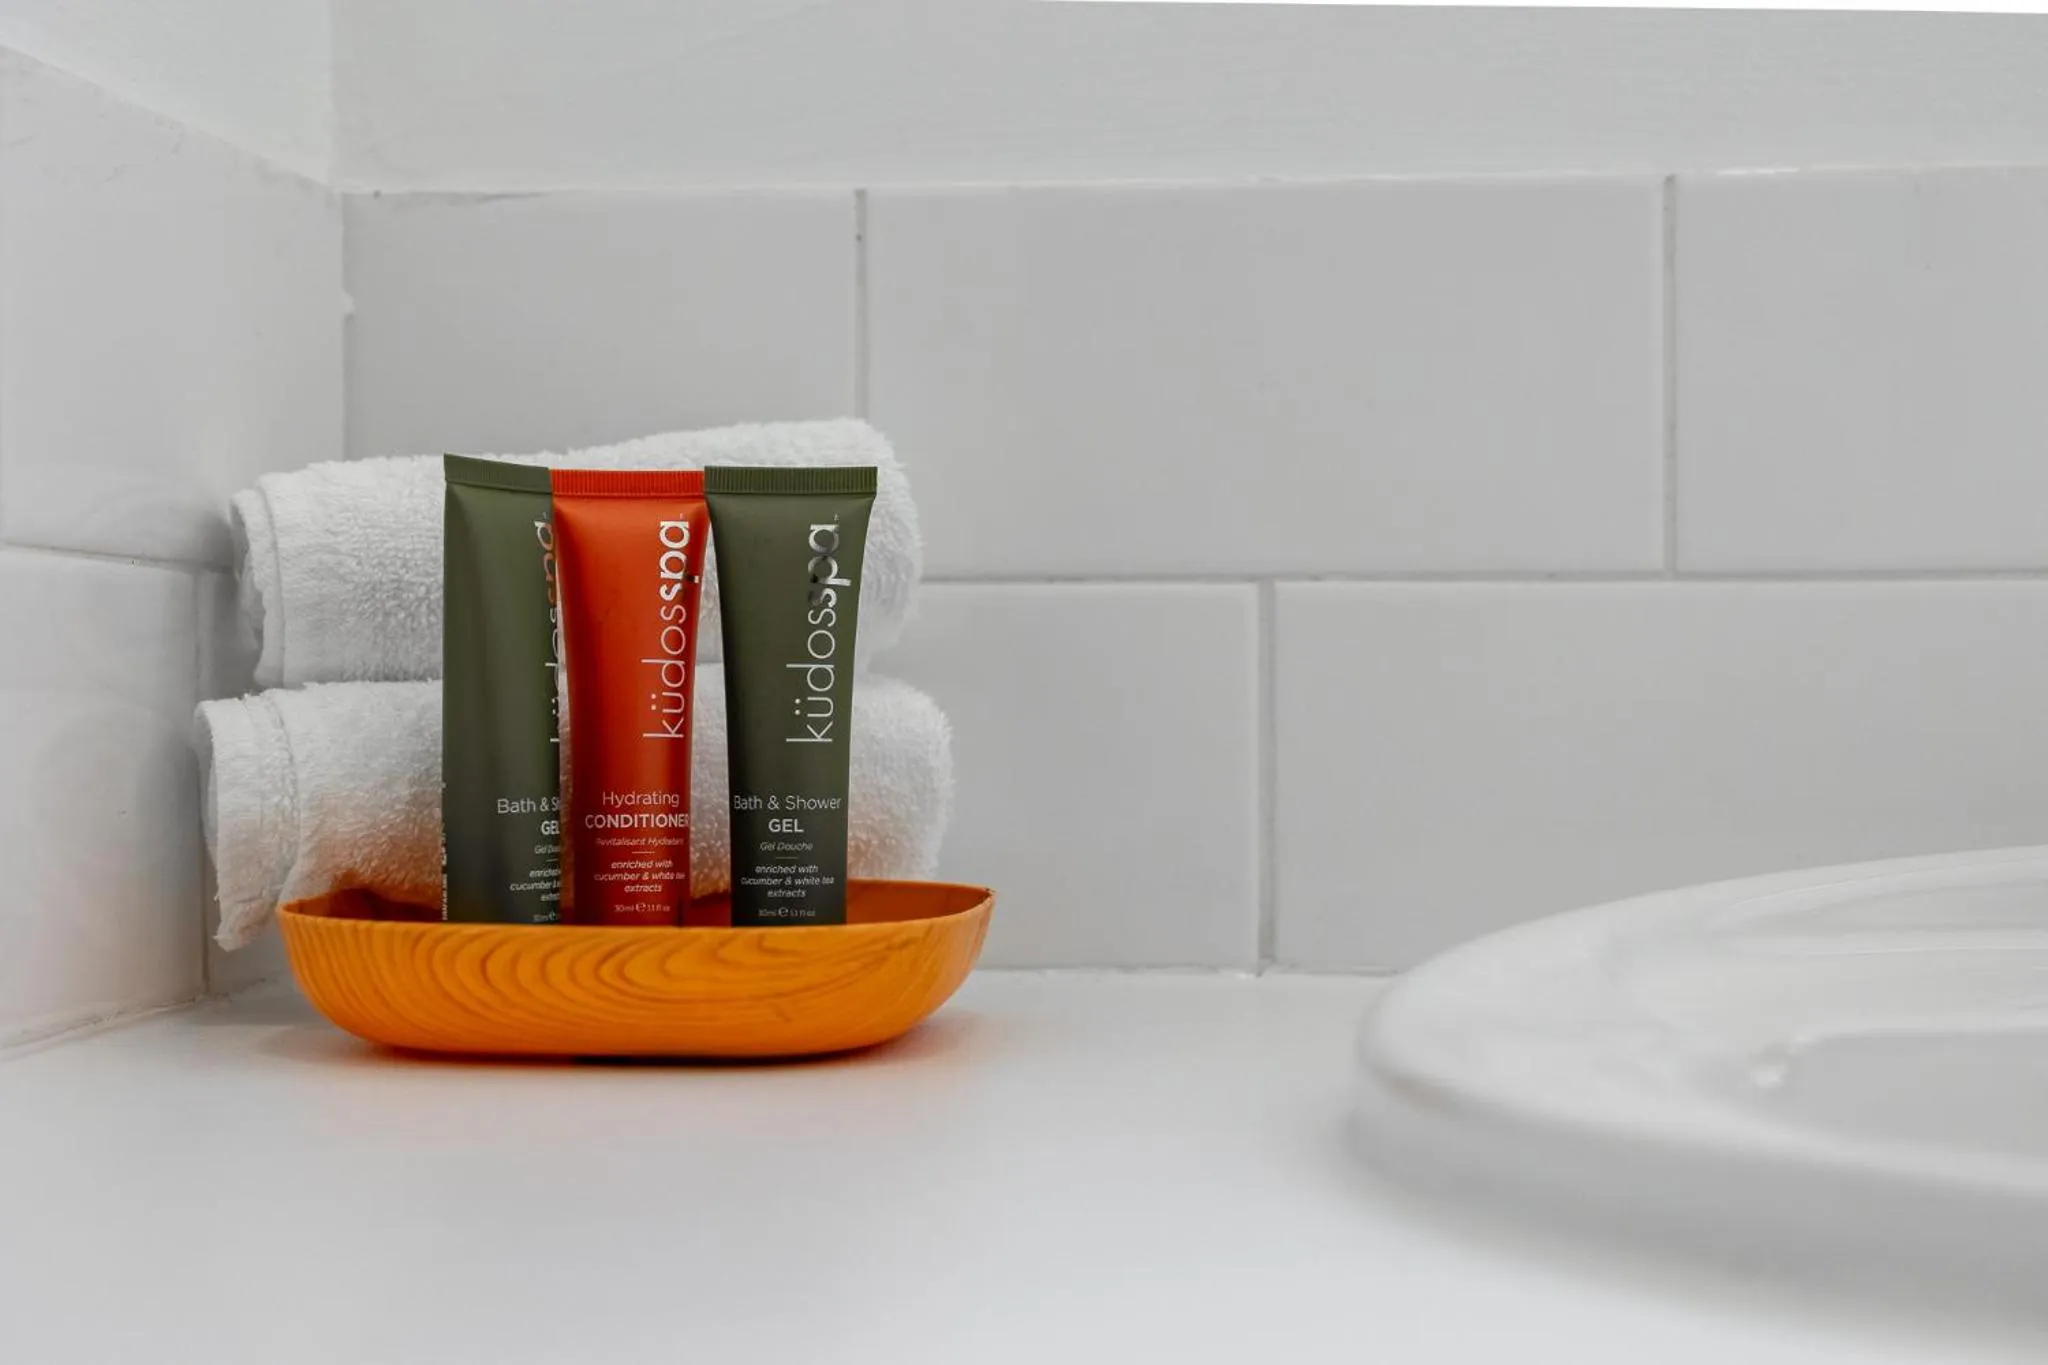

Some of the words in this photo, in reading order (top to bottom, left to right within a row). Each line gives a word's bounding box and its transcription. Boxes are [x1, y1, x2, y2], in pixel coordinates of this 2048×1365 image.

[602, 791, 680, 808] Hydrating
[733, 795, 763, 810] Bath
[767, 794, 780, 810] &
[785, 794, 842, 810] Shower
[497, 797, 536, 814] Bath
[539, 796, 549, 812] &
[768, 818, 804, 833] GEL
[760, 841, 776, 851] Gel
[777, 841, 813, 851] Douche
[611, 860, 654, 869] enriched
[655, 859, 674, 869] with
[755, 864, 796, 874] enriched
[798, 864, 818, 874] with
[642, 871, 650, 881] &
[784, 876, 792, 886] &
[795, 876, 820, 885] white
[624, 883, 662, 893] extracts
[767, 888, 807, 898] extracts
